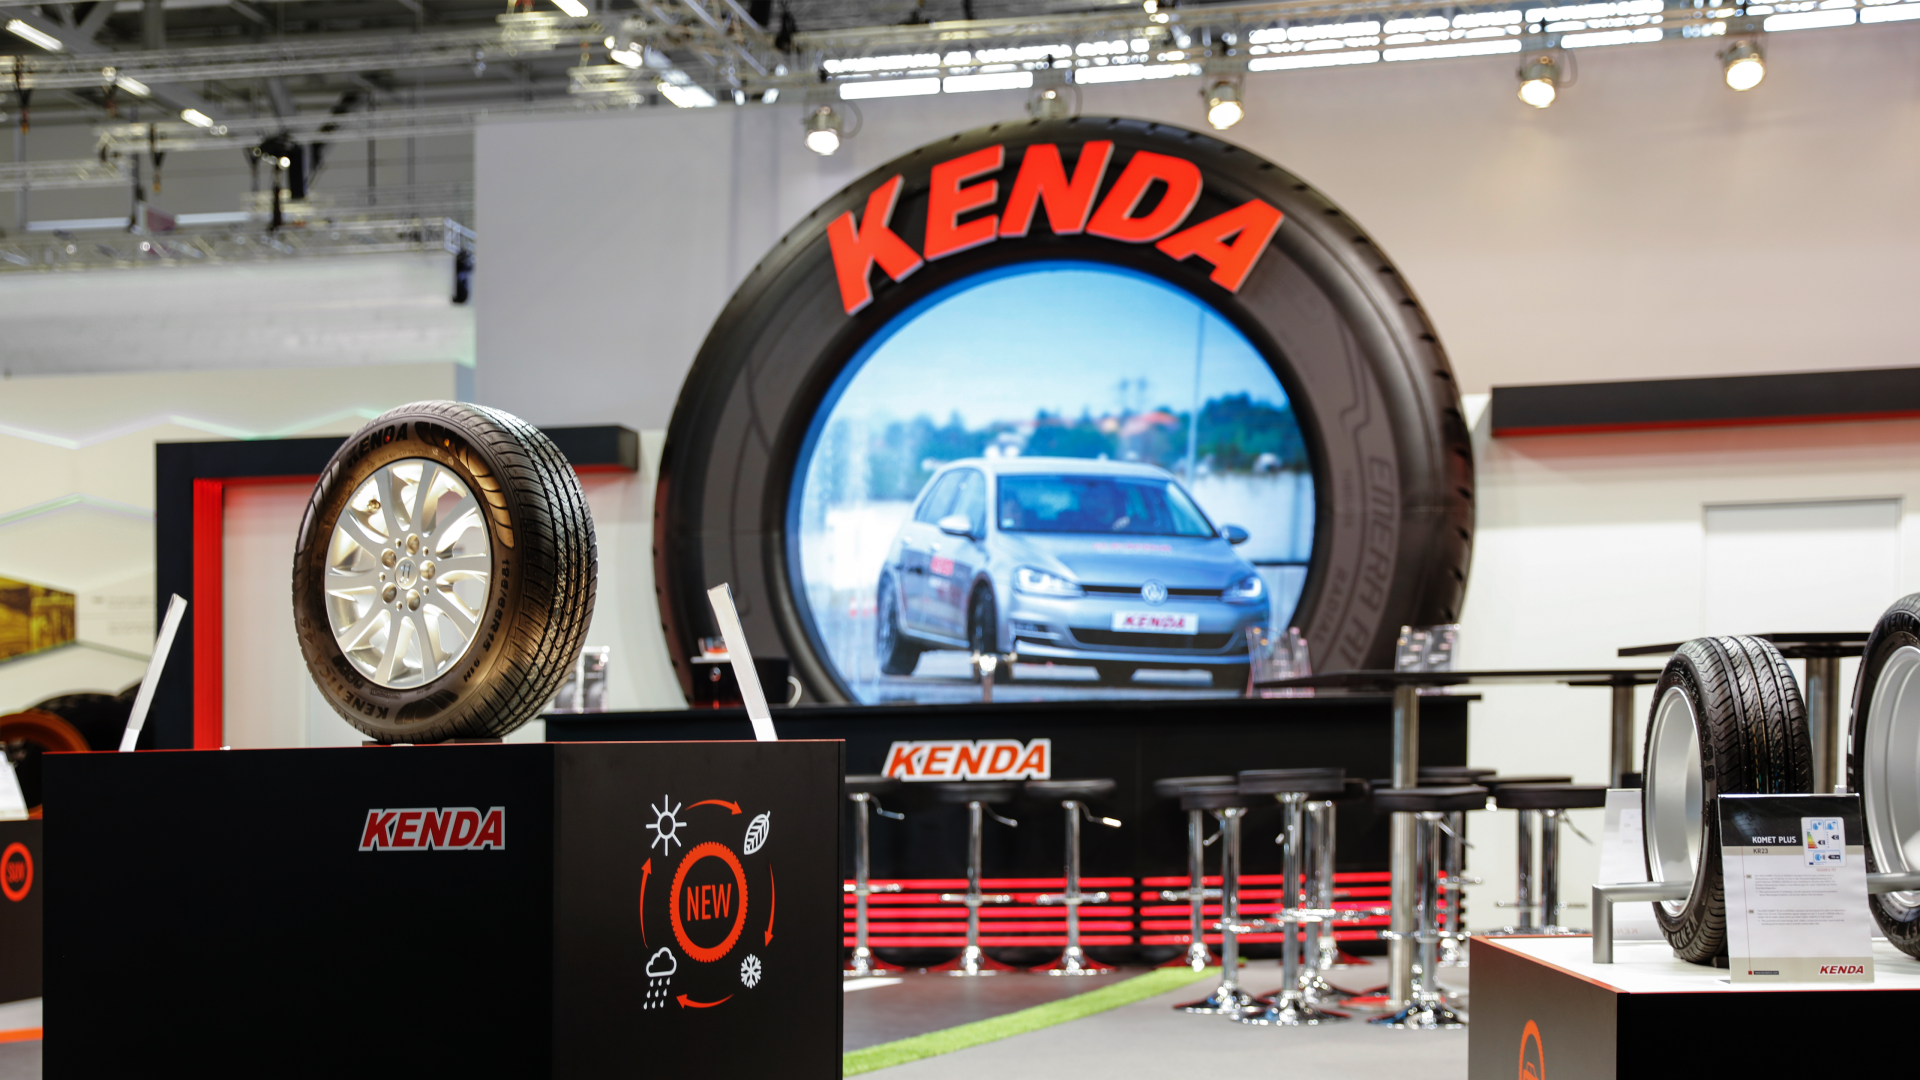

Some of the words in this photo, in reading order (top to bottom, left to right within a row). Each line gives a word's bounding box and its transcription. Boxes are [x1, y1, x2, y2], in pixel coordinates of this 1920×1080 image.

[826, 140, 1284, 315] KENDA
[346, 422, 408, 468] KENDA
[1360, 456, 1396, 614] EMERA
[1123, 614, 1186, 629] KENDA
[313, 652, 390, 720] KENETICA
[883, 739, 1051, 781] KENDA
[359, 807, 505, 851] KENDA
[1752, 836, 1776, 844] KOMET
[1778, 836, 1797, 844] PLUS
[687, 883, 732, 922] NEW
[1819, 965, 1865, 975] KENDA
